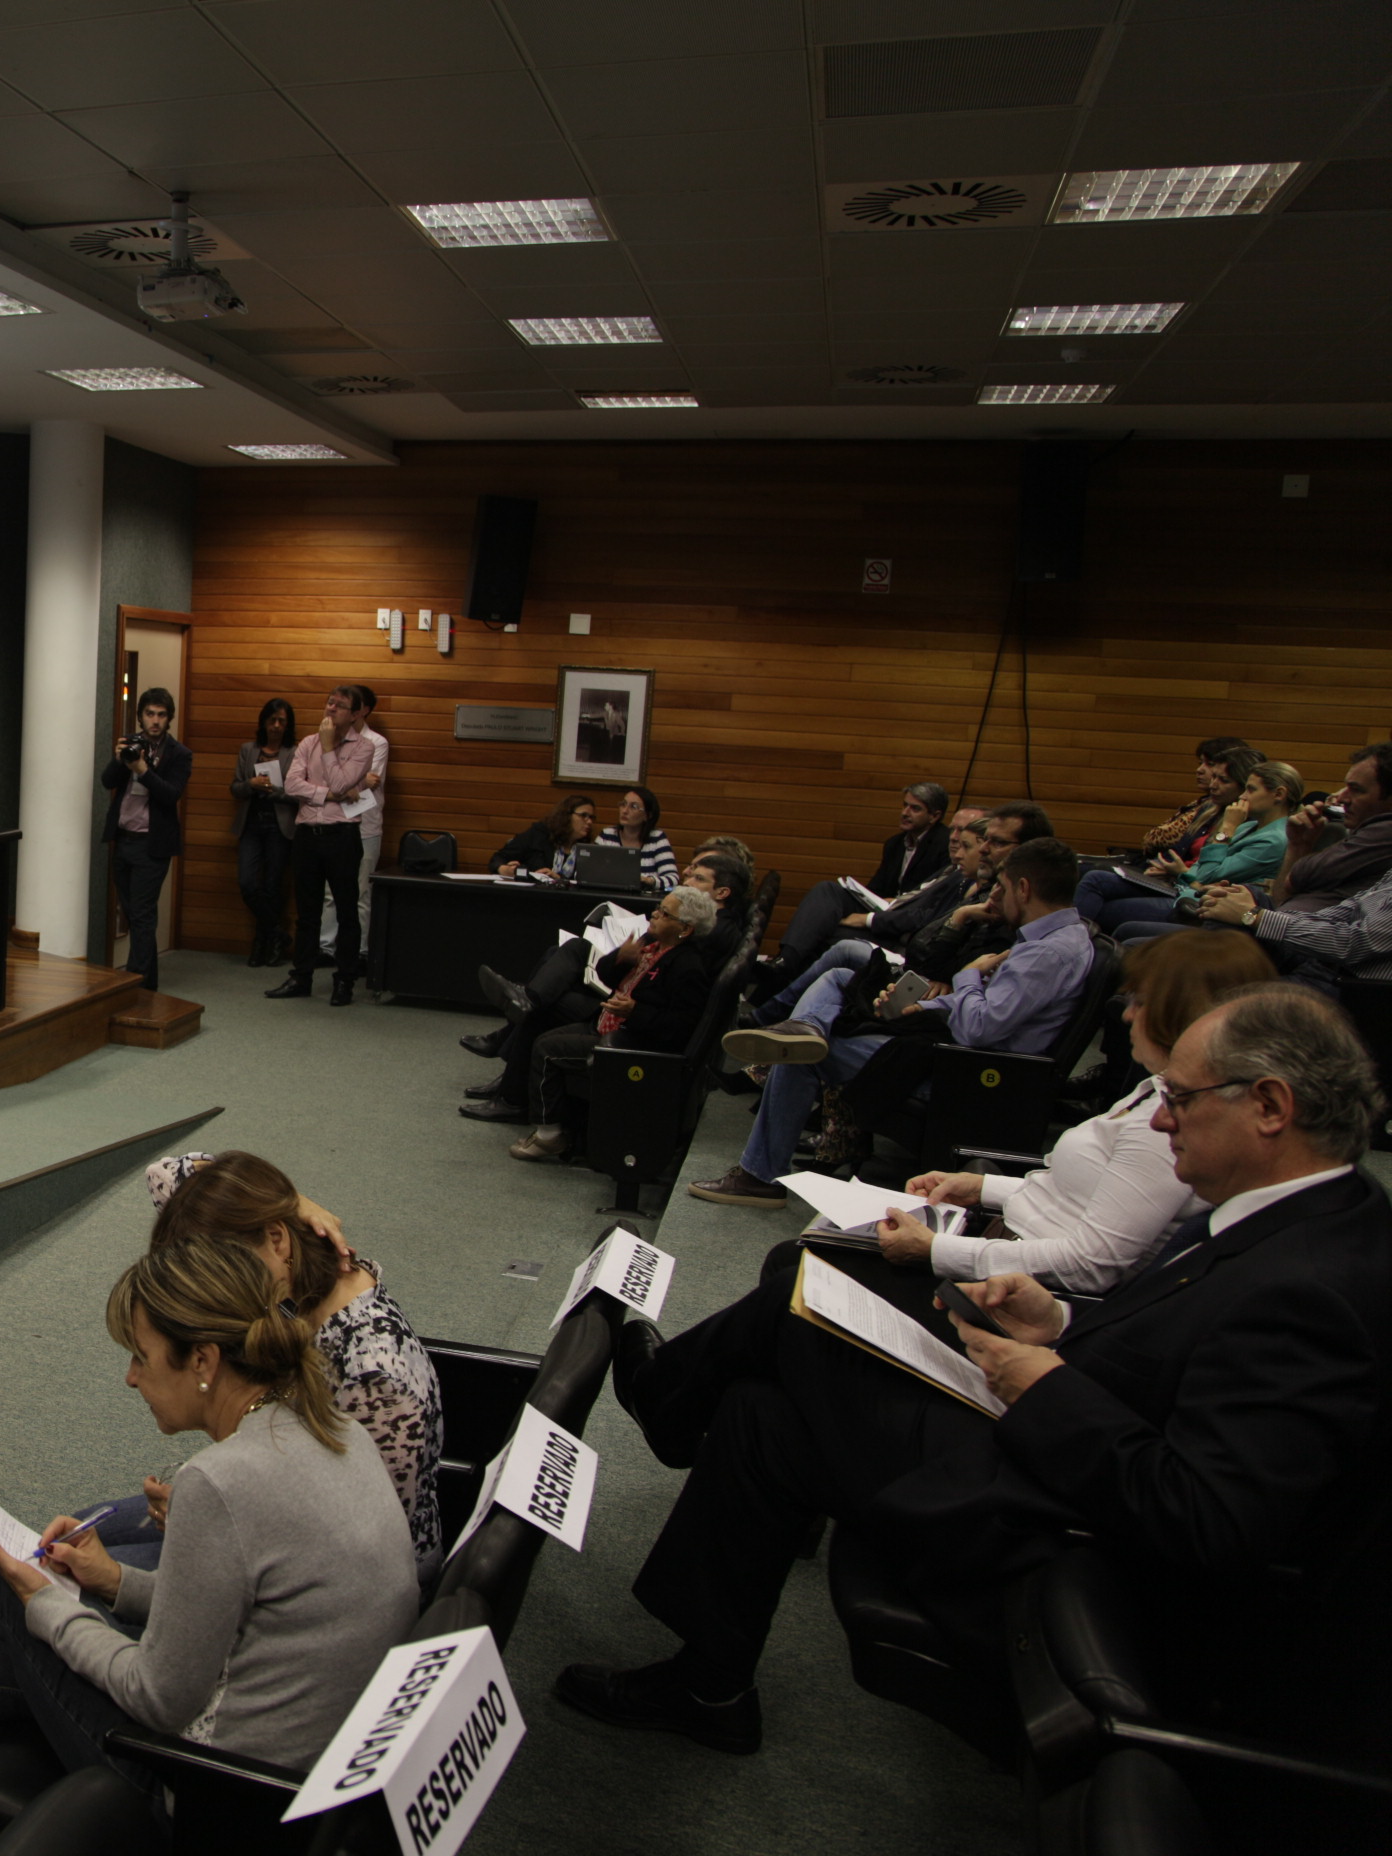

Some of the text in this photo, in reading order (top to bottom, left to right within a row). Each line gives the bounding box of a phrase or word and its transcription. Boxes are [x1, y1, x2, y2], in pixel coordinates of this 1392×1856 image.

[632, 1070, 640, 1078] A
[986, 1073, 995, 1082] B
[619, 1244, 660, 1307] RESERVADO
[527, 1431, 581, 1531] RESERVADO
[333, 1644, 458, 1792] RESERVADO
[405, 1680, 508, 1856] RESERVADO
